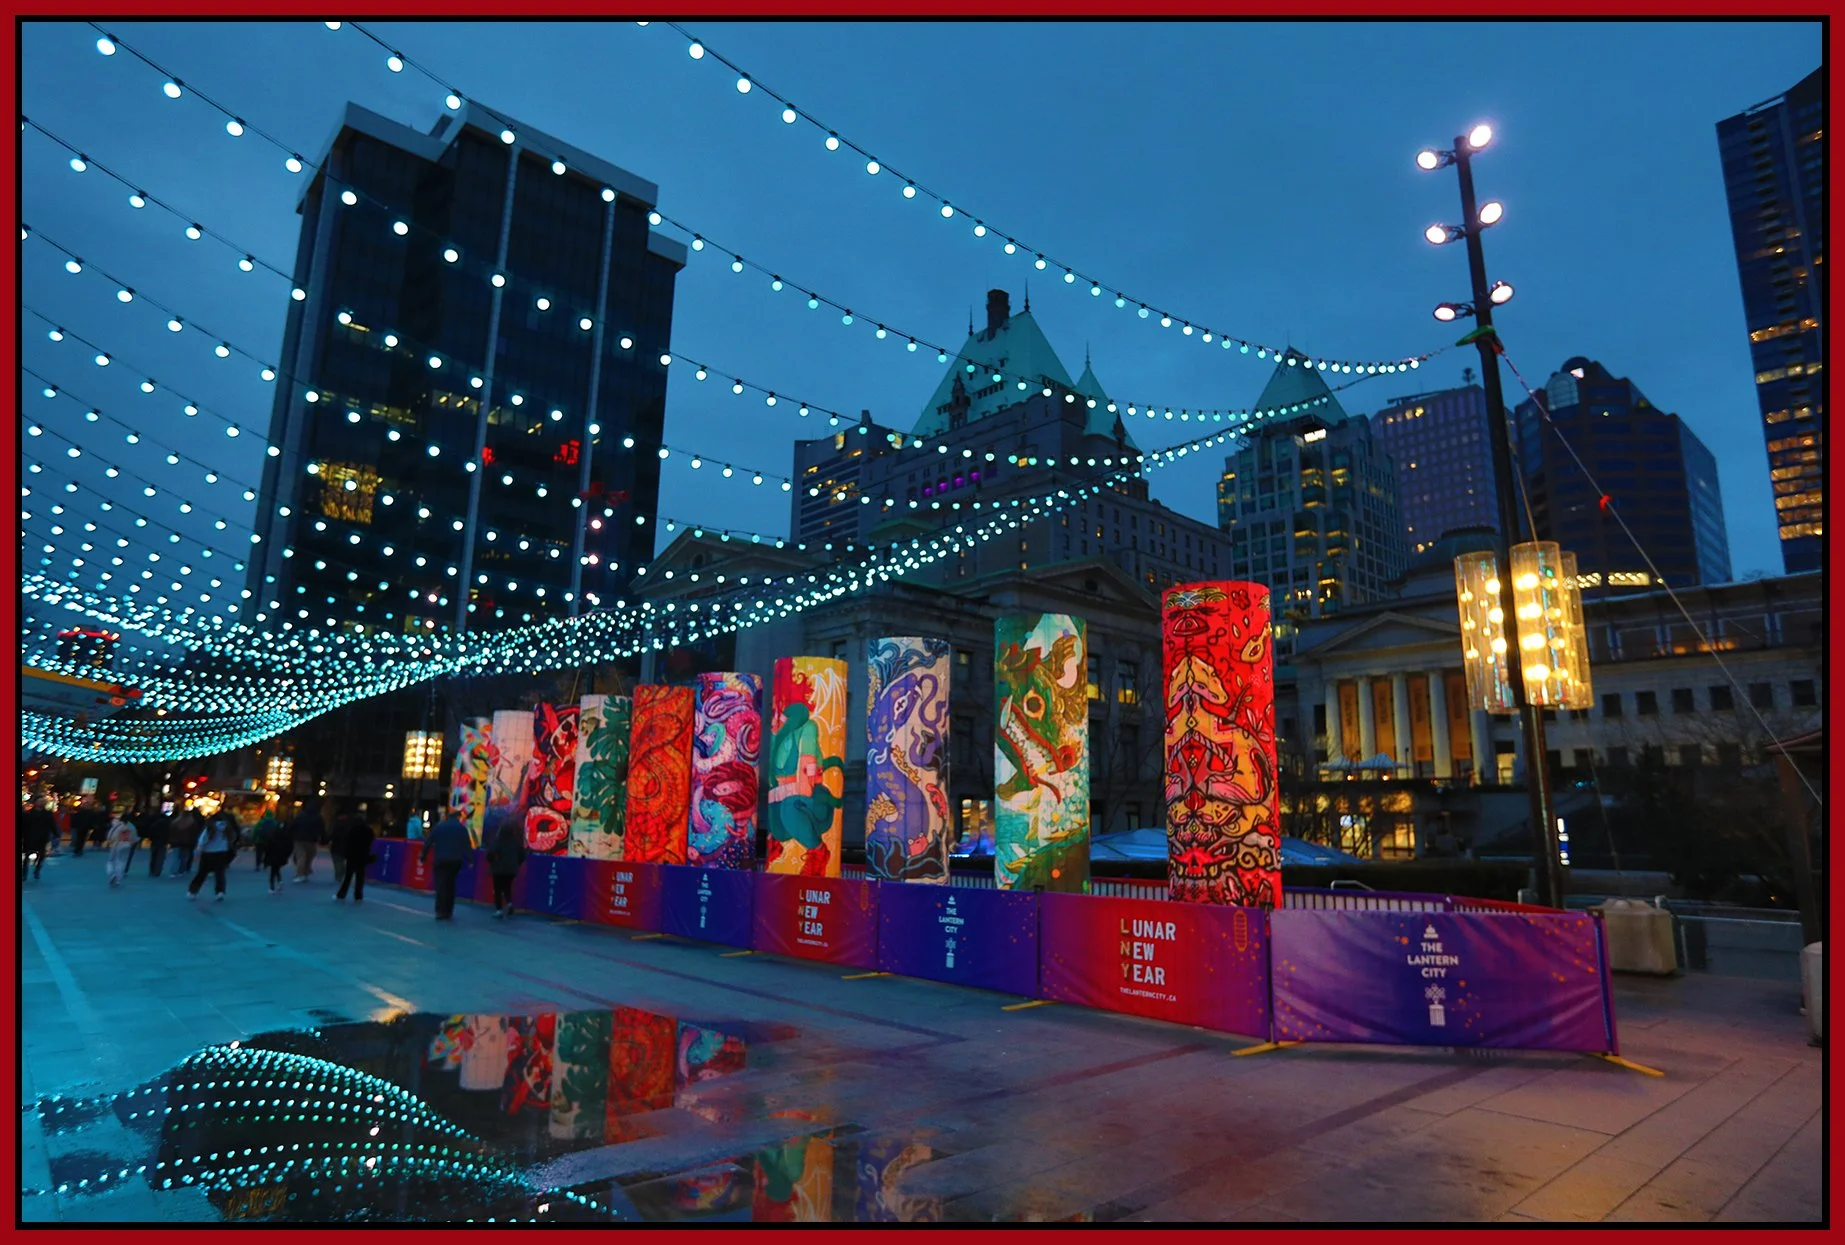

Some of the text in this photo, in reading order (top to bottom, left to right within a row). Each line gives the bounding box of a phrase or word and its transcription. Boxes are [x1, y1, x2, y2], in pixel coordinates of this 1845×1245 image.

[799, 889, 831, 904] LUNAR
[798, 905, 819, 919] NEW
[946, 907, 957, 915] THE
[798, 921, 823, 936] YEAR
[945, 925, 958, 934] CITY
[1120, 918, 1176, 941] LUNAR
[1120, 940, 1155, 961] NEW
[1420, 942, 1443, 953] THE
[1407, 954, 1459, 966] LANTERN
[1120, 963, 1165, 986] YEAR
[1421, 967, 1447, 978] CITY
